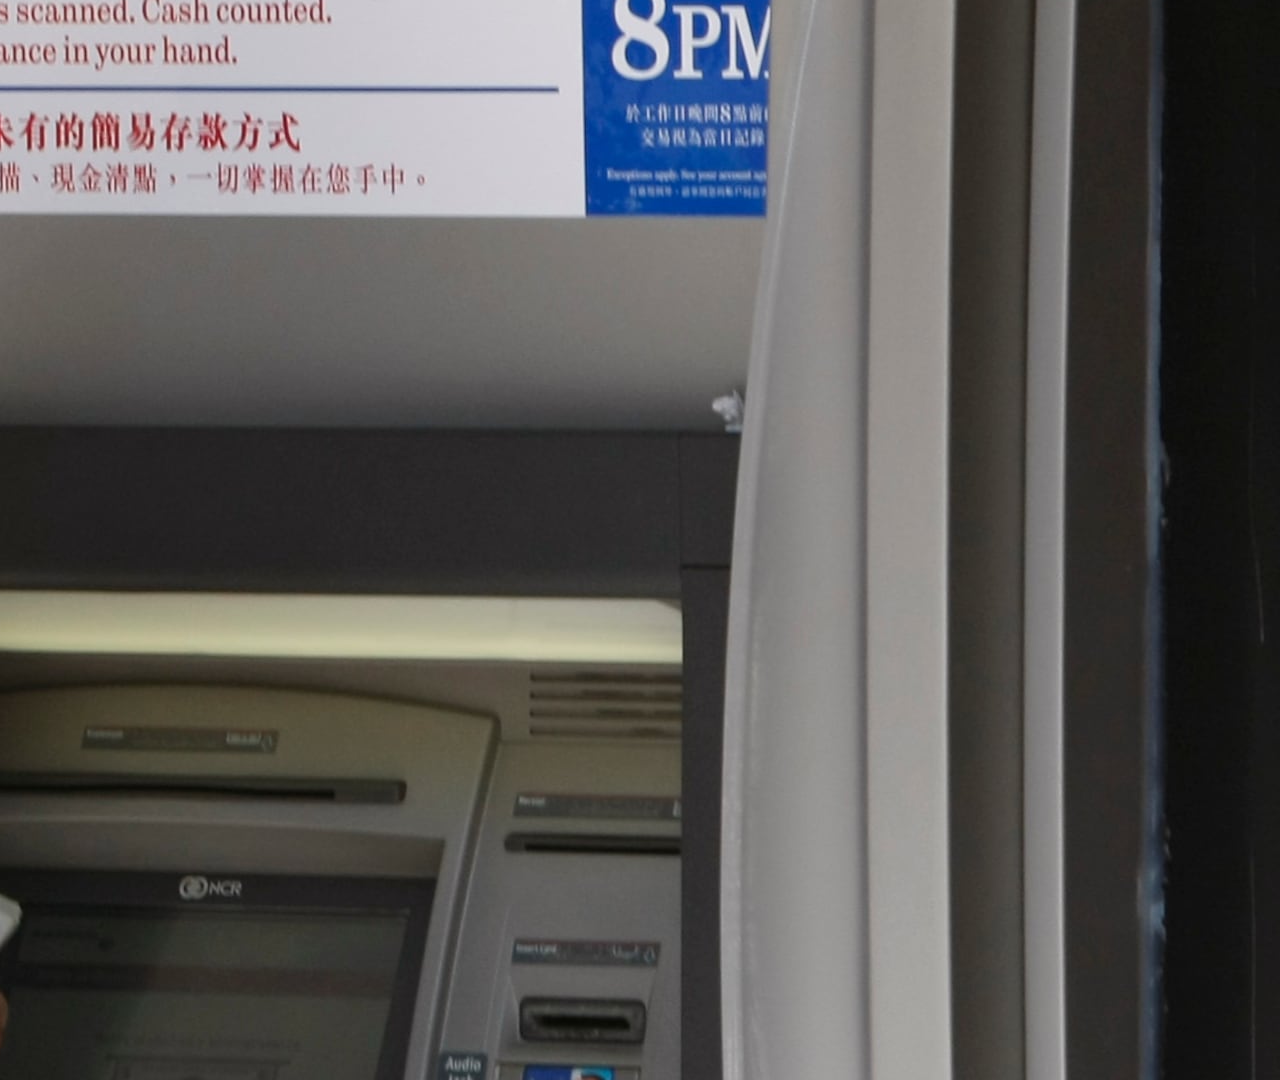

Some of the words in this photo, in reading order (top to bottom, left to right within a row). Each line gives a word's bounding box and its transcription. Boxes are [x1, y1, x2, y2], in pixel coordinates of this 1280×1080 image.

[63, 36, 89, 64] in
[94, 44, 156, 71] your
[163, 36, 238, 65] hand.
[209, 880, 242, 896] NCR
[445, 1056, 481, 1072] Audio
